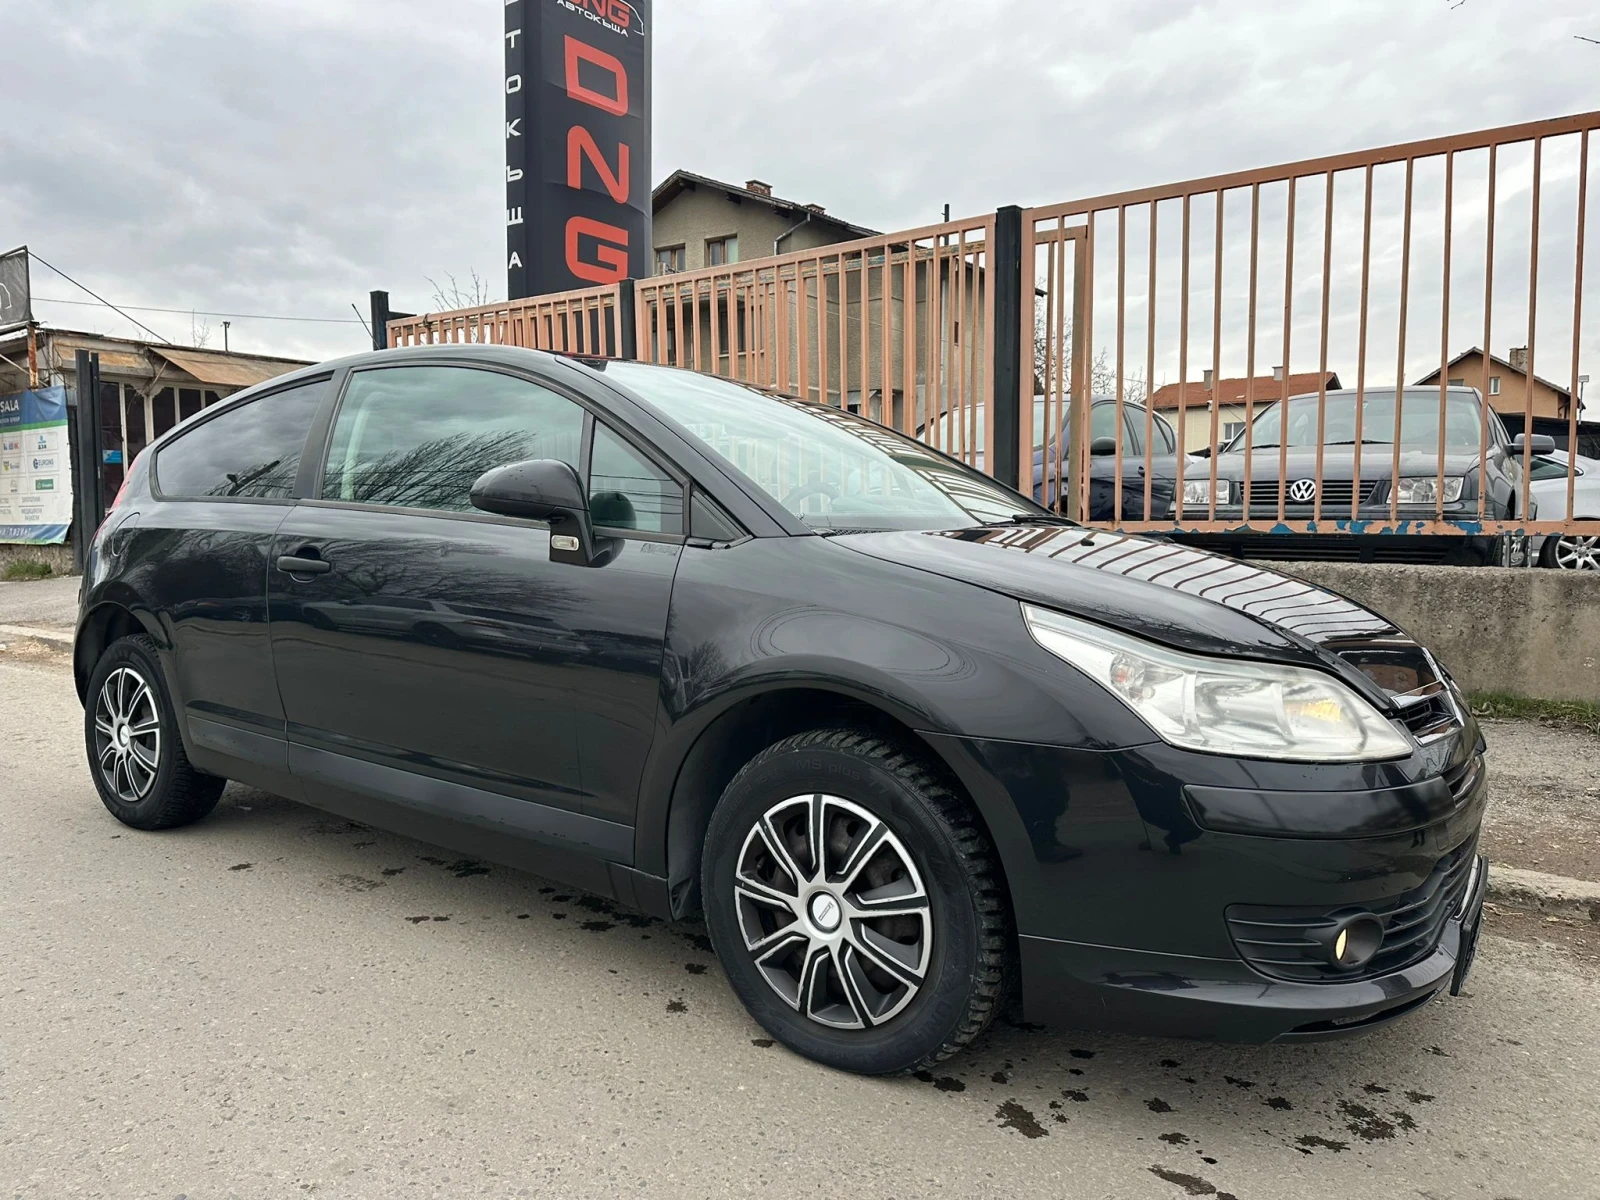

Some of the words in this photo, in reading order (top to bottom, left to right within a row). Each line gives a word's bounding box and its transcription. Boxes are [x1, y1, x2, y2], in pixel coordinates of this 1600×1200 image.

[506, 0, 523, 268] ТОКЪЩА
[0, 399, 20, 413] SALA
[828, 763, 861, 782] plus
